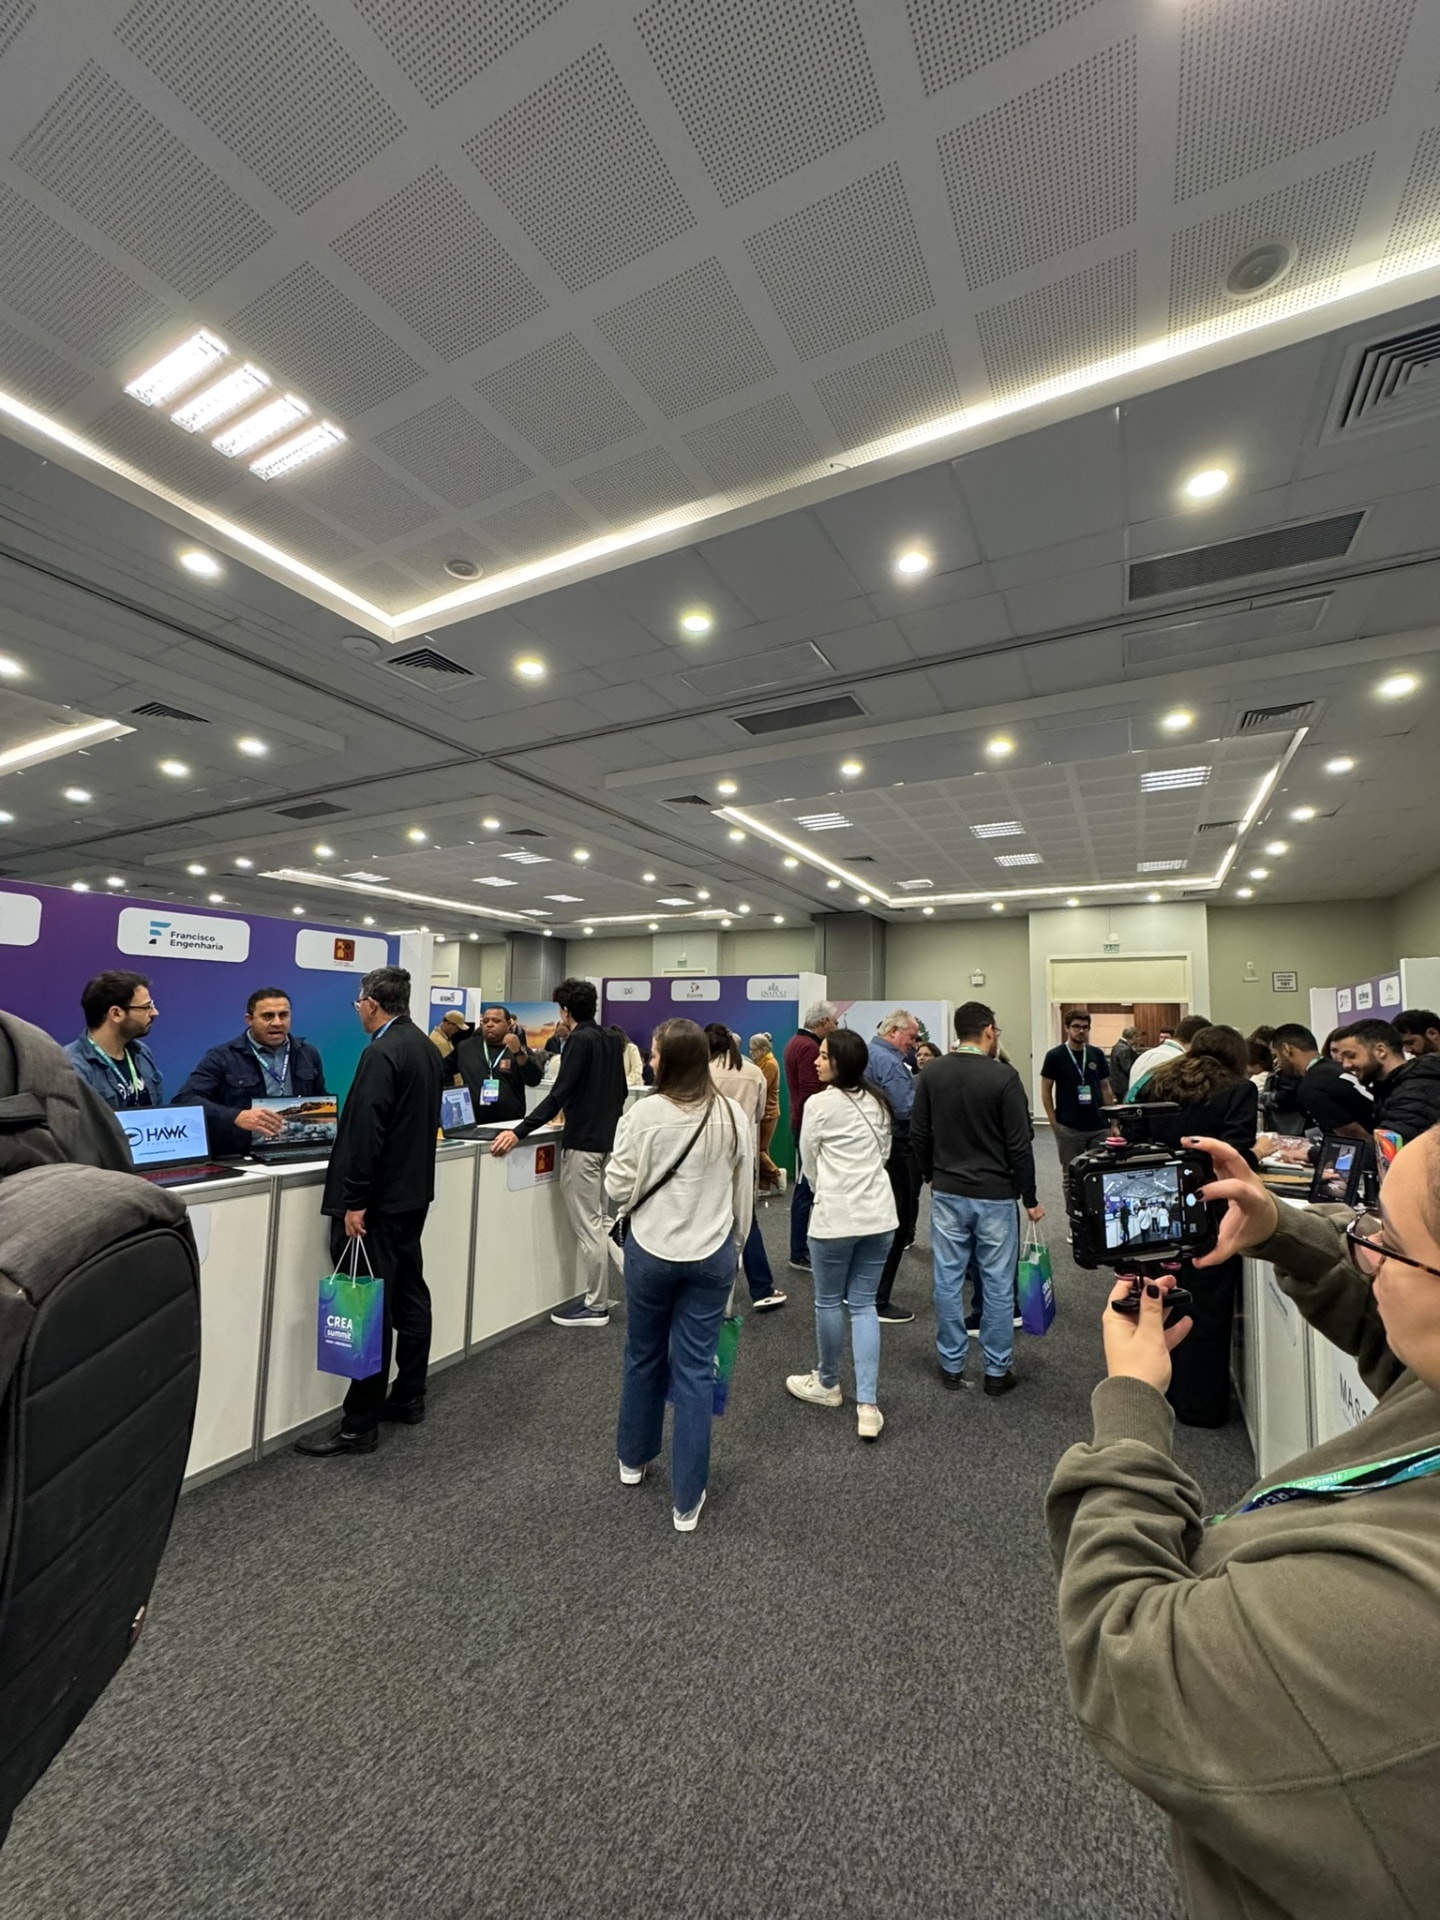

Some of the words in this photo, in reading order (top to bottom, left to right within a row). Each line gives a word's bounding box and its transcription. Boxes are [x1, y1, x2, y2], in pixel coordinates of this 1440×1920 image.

[170, 931, 216, 942] Francisco
[169, 939, 224, 951] Engenharia
[146, 1125, 189, 1142] HAWK
[326, 1315, 353, 1329] CREA
